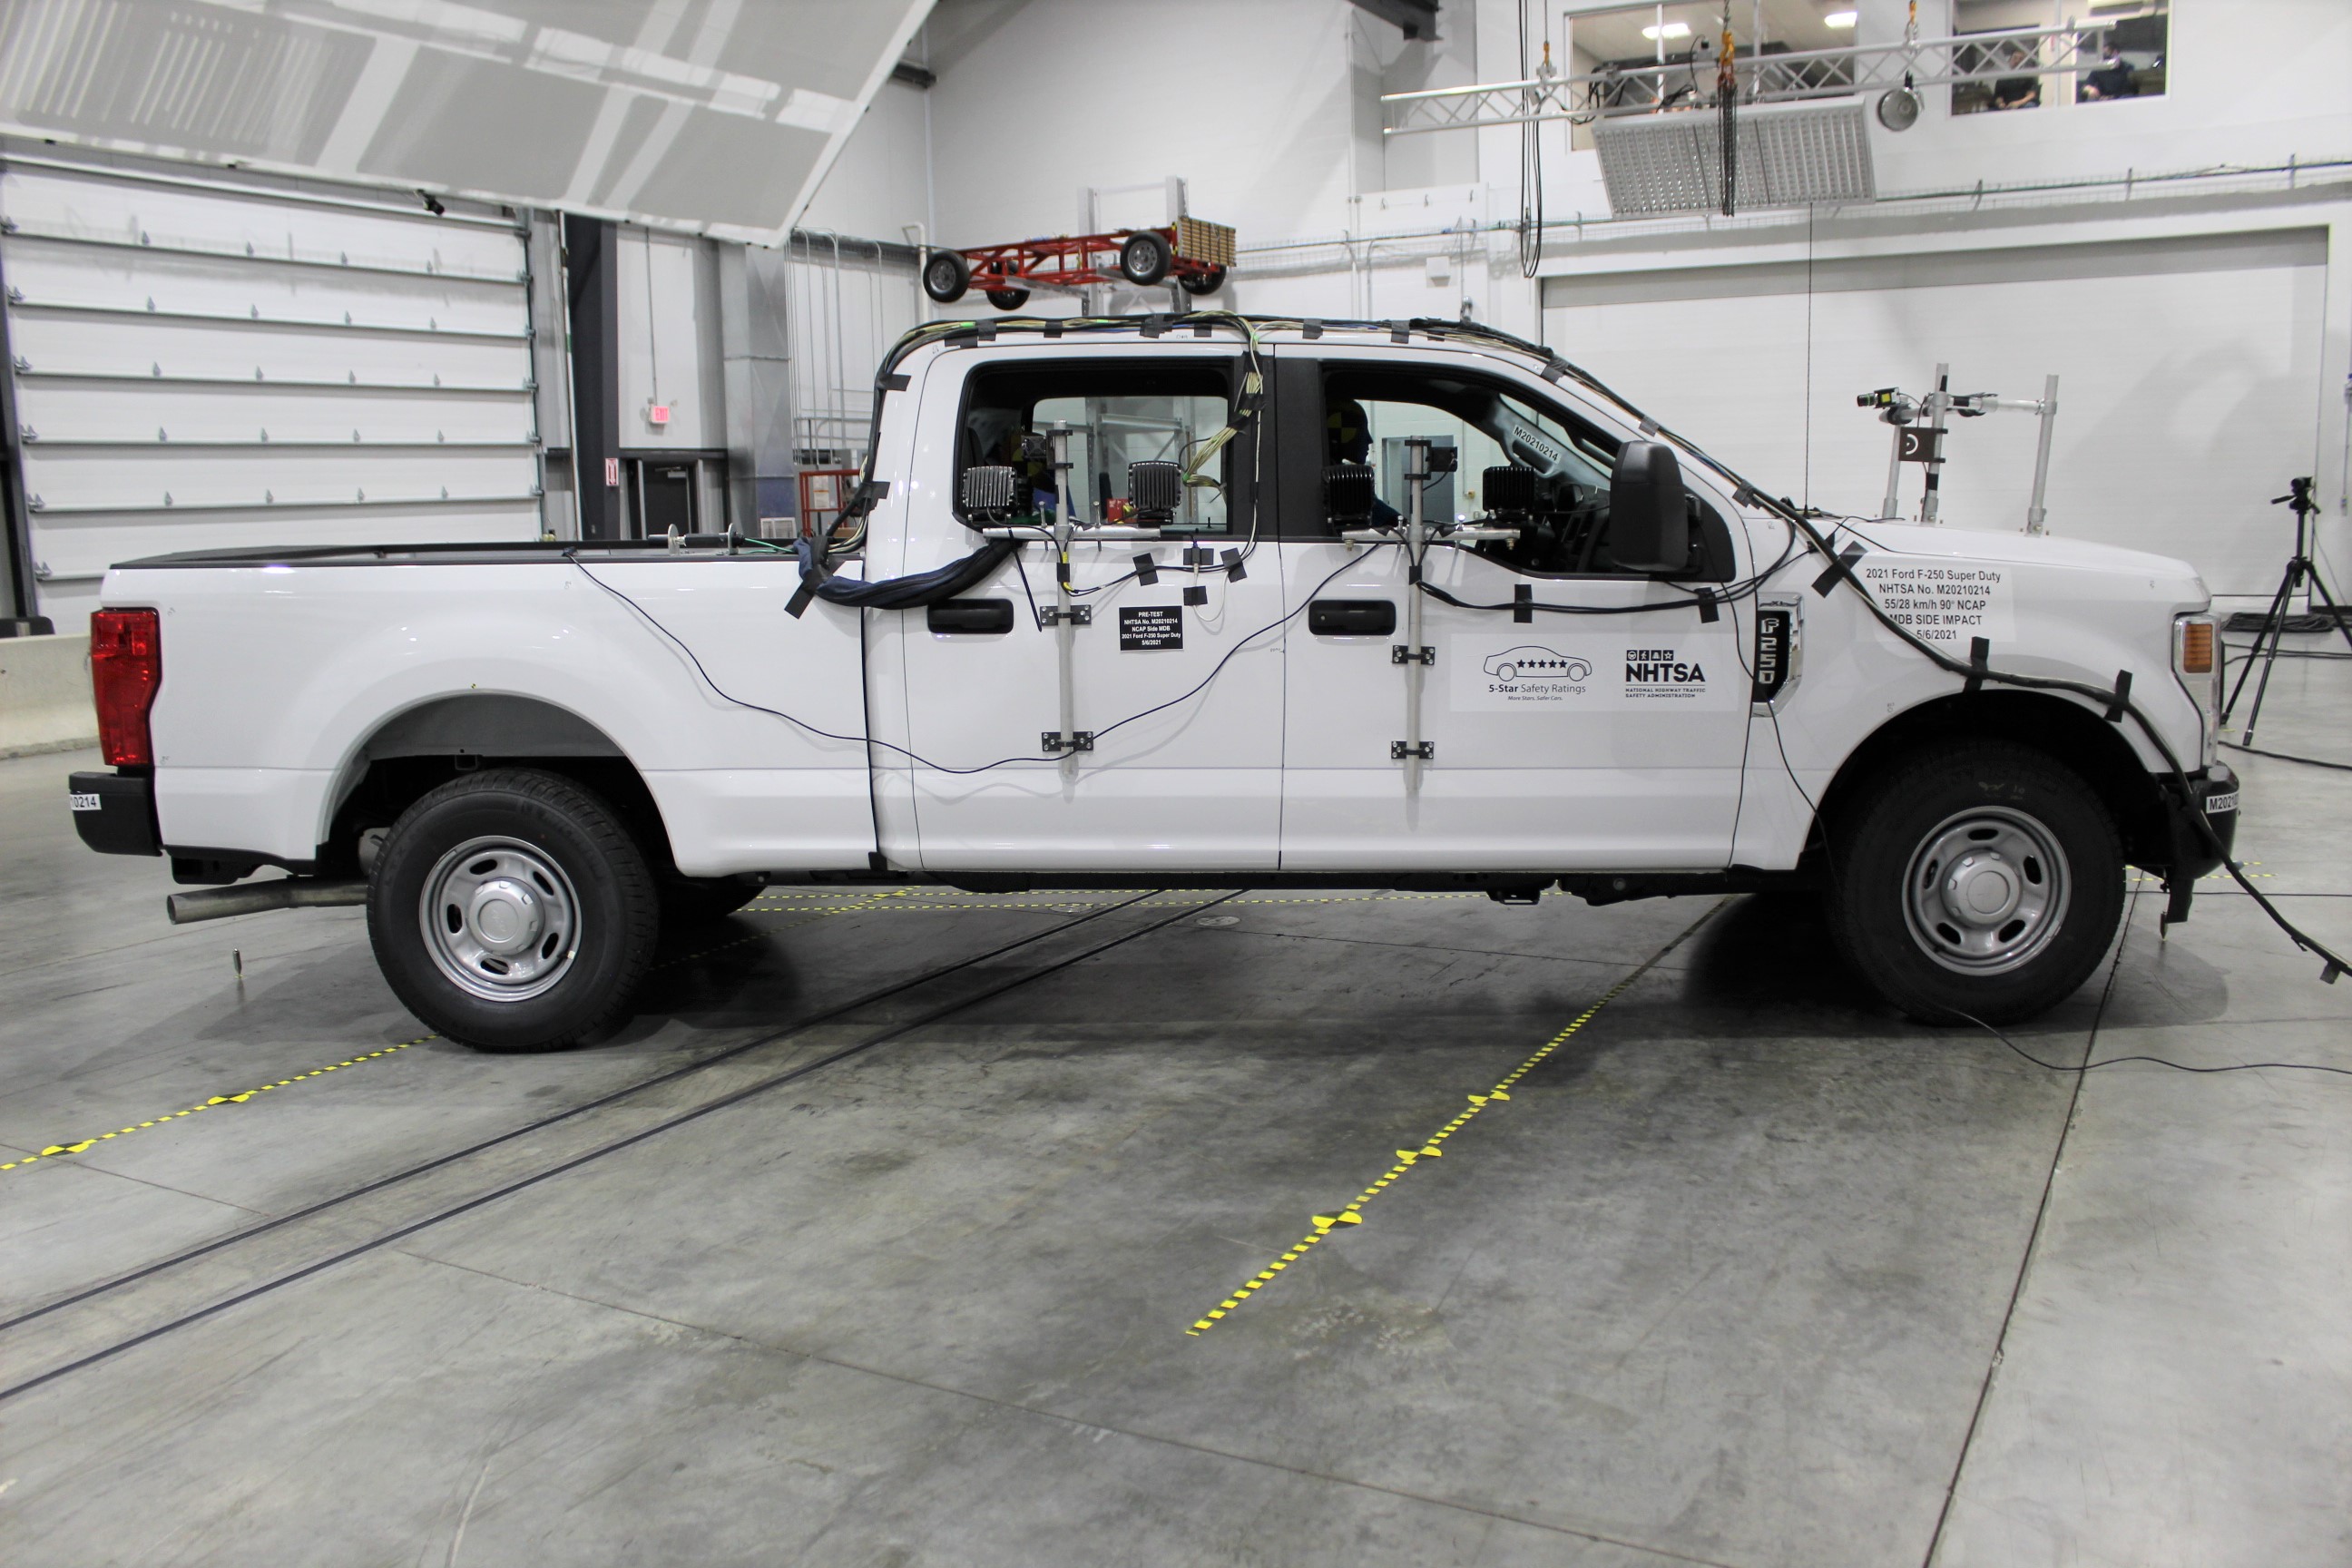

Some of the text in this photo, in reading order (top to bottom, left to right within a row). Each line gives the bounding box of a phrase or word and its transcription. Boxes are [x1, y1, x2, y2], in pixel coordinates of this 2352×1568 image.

[1514, 426, 1559, 461] M20210214
[1866, 568, 2001, 583] 2021 Ford F-250 Super Duty
[1878, 583, 1991, 595] NHTSA No. M20210214
[1884, 598, 1986, 611] 55/28 km/h 90° NCAP
[1888, 613, 1983, 625] MDB SIDE IMPACT
[1916, 630, 1957, 640] 5/6/2021
[1625, 662, 1706, 682] NHTSA
[1488, 683, 1586, 695] 5-Star Safety Ratings
[74, 797, 97, 808] 0214
